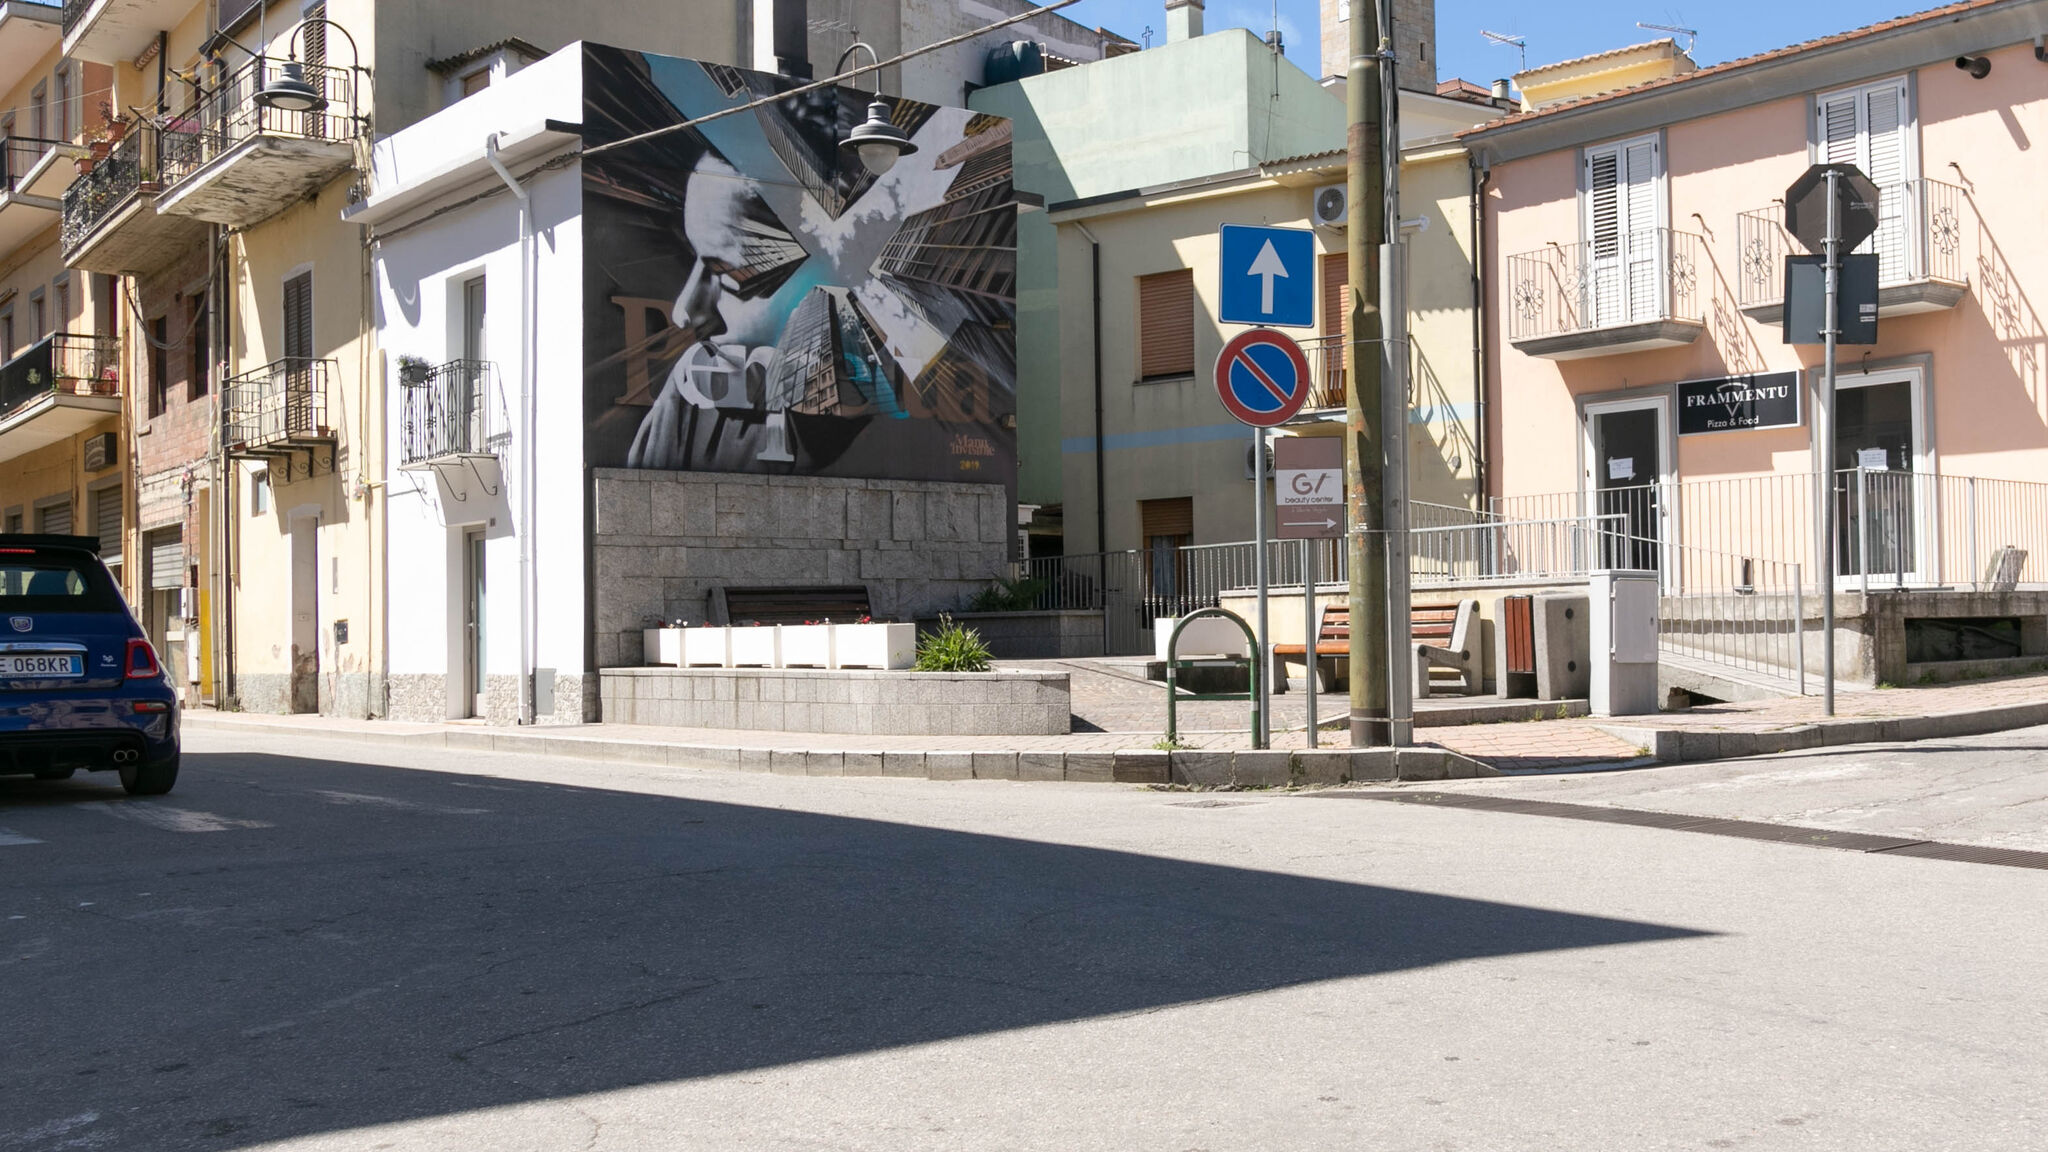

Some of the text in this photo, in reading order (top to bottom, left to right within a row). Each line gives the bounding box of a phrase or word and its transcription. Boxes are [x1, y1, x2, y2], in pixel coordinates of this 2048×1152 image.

[1687, 385, 1789, 407] FRAMMENTU
[1707, 415, 1760, 428] Pizza & Food
[1311, 496, 1334, 504] center
[14, 658, 69, 672] 068KR
